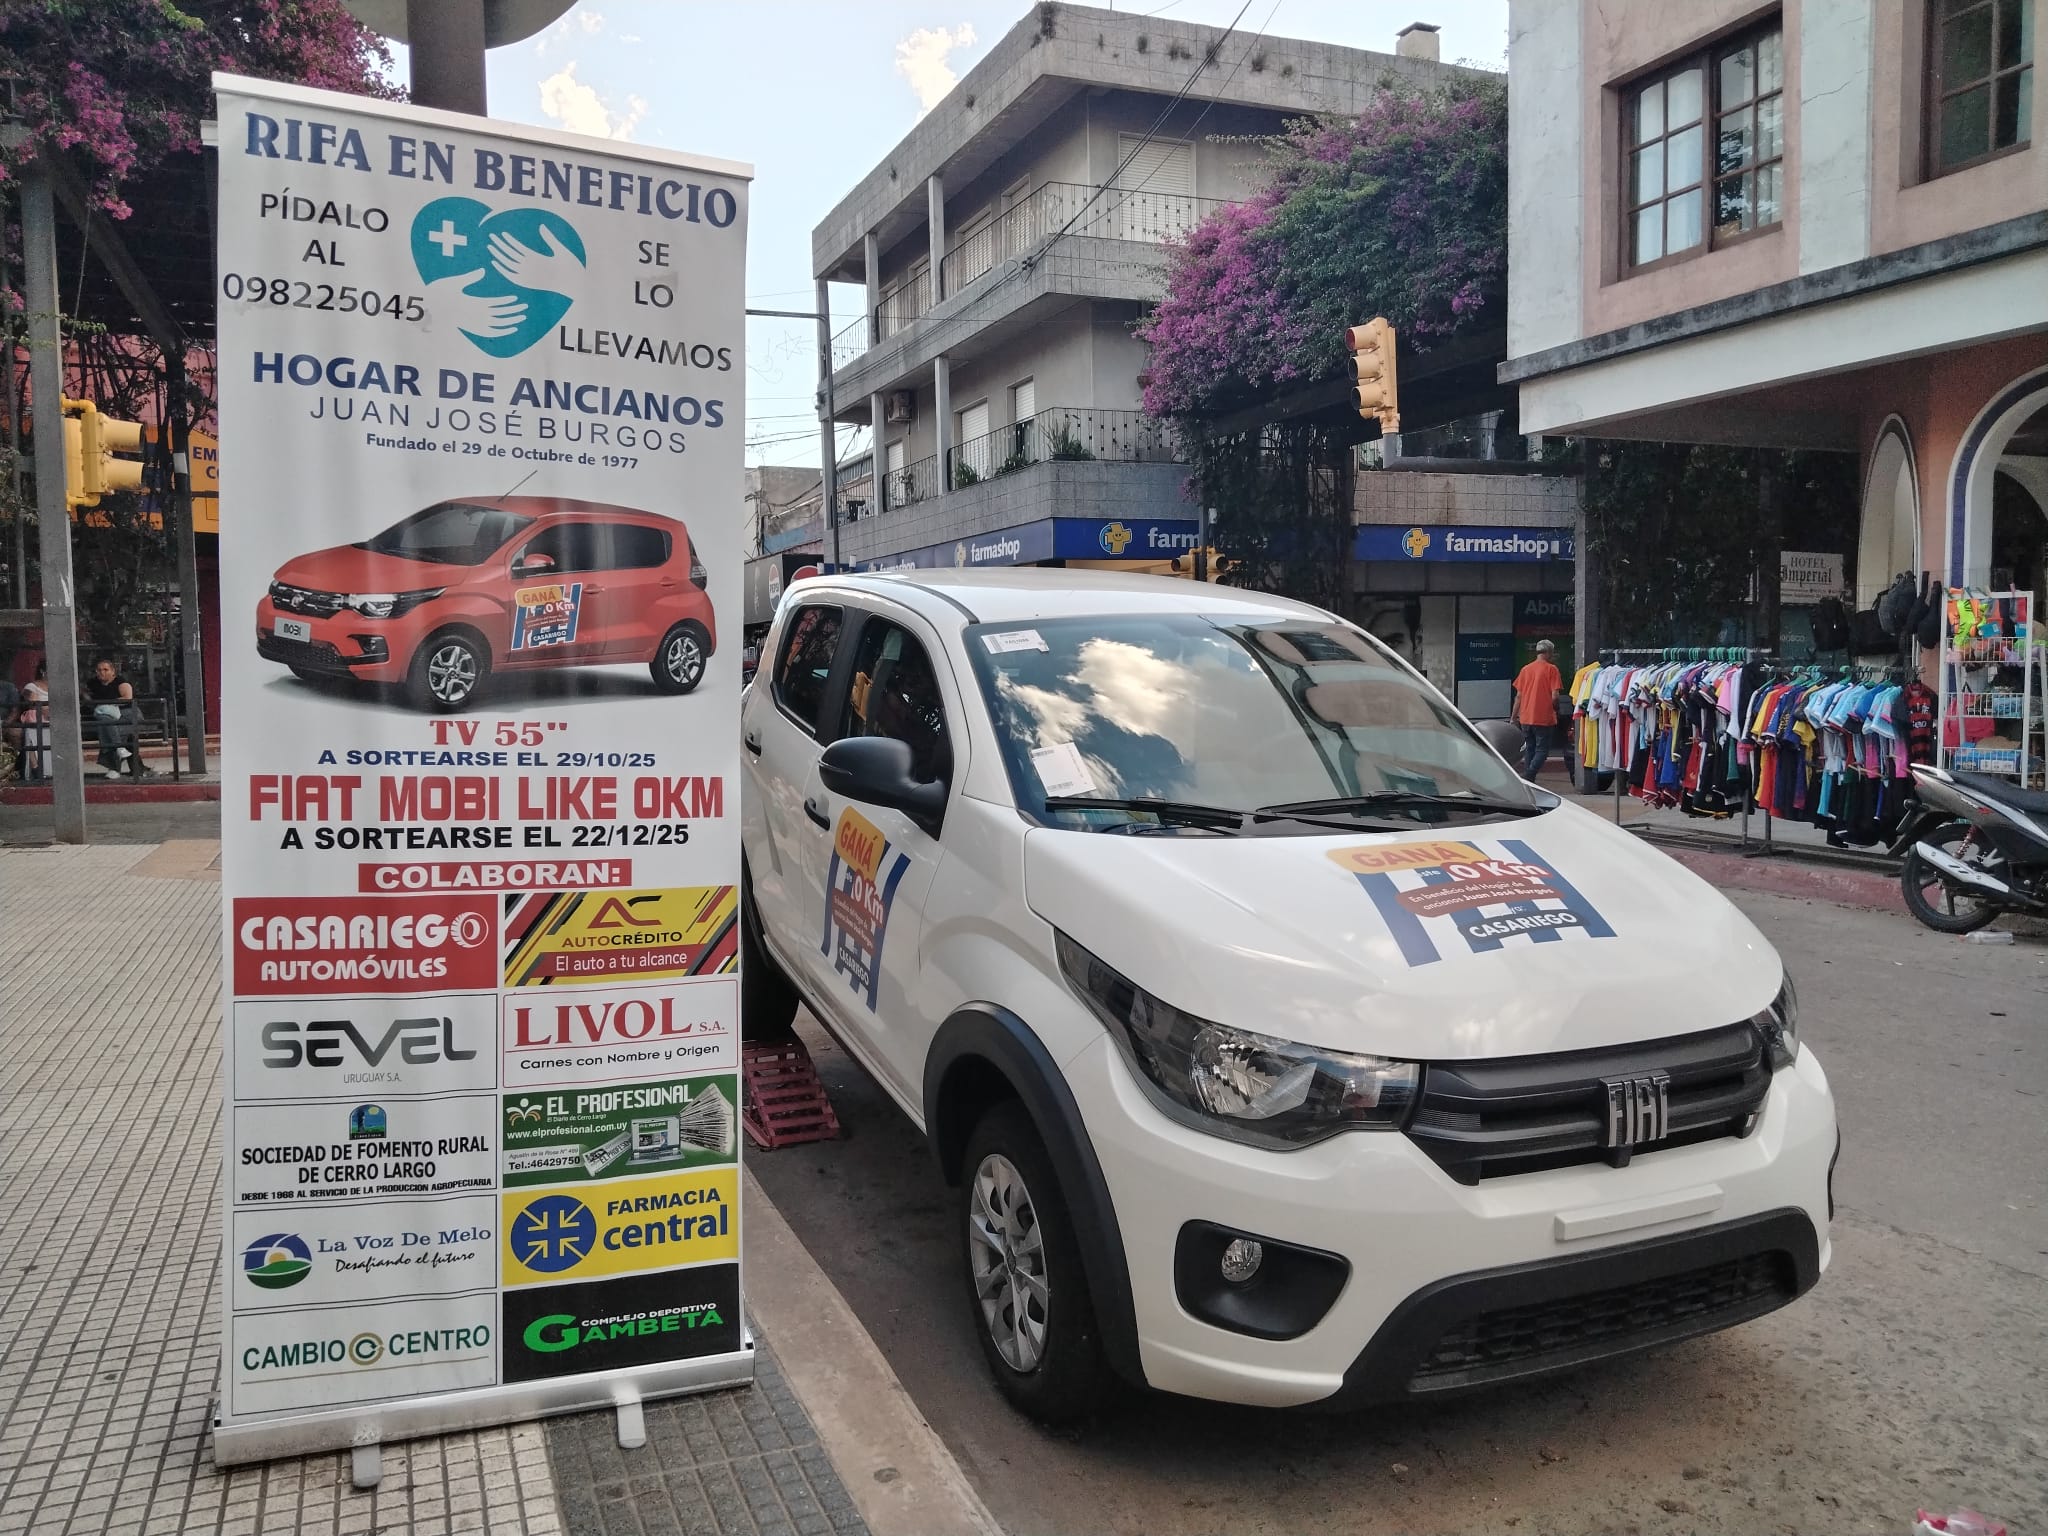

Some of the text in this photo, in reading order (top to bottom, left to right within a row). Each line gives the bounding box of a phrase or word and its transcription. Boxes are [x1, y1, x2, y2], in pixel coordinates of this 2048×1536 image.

[245, 112, 737, 229] RIFA EN BENEFICIO
[260, 188, 389, 233] PÍDALO
[302, 239, 345, 267] AL
[638, 240, 670, 267] SE
[222, 273, 425, 322] 098225045
[635, 280, 674, 308] LO
[559, 325, 732, 372] LLEVAMOS
[253, 351, 724, 429] HOGAR DE ANCIANOS
[311, 396, 686, 454] JUAN JOSÉ BURGOS
[366, 433, 639, 469] Fundado el 29 de Octubre de 1977
[970, 537, 1020, 563] farmashop
[1445, 532, 1549, 559] farmashop
[1790, 556, 1827, 569] HOTEL
[523, 588, 556, 604] GANÁ
[556, 600, 575, 611] Km
[430, 720, 481, 746] TV
[318, 750, 656, 768] A SORTEARSE EL 29/10/25
[250, 775, 361, 821] FIAT
[380, 775, 500, 821] MOBI
[517, 776, 616, 821] LIKE
[280, 824, 689, 849] A SORTEARSE EL 22/12/25
[840, 820, 879, 873] GANÁ
[1352, 843, 1467, 867] GANÁ
[374, 863, 621, 890] COLABORAN:
[1477, 861, 1549, 878] Km
[1464, 883, 1480, 893] del
[1464, 892, 1491, 902] Juan
[240, 911, 489, 951] CASARIEGO
[1468, 912, 1578, 938] CASARIEGO
[561, 930, 682, 948] AUTOCRÉDITO
[260, 956, 447, 981] AUTOMÓVILES
[555, 950, 688, 971] El auto a tu alcance
[514, 997, 726, 1047] LIVOL S.A.
[261, 1016, 477, 1069] SEVEL
[519, 1044, 720, 1070] Carnes con Nombre y Origen
[343, 1071, 401, 1084] URUGUAY S.A.
[547, 1084, 693, 1116] EL PROFESIONAL
[1607, 1075, 1671, 1148] FIAT
[507, 1122, 628, 1140] www.elprofesional.com.uy
[241, 1136, 489, 1165] SOCIEDAD DE FOMENTO RURAL
[299, 1161, 436, 1184] DE CERRO LARGO
[242, 1192, 269, 1201] DESDE
[297, 1189, 308, 1198] AL
[310, 1187, 348, 1198] SERVICIO
[350, 1186, 361, 1195] DE
[363, 1185, 374, 1194] LA
[376, 1183, 429, 1193] PRODUCCION
[431, 1178, 492, 1191] AGROPECUARIA
[606, 1188, 721, 1217] FARMACIA
[317, 1227, 492, 1254] La Voz De Melo
[602, 1204, 728, 1252] central
[335, 1250, 476, 1273] Desafiando el futuro
[581, 1303, 717, 1327] COMPLEJO DEPORTIVO
[523, 1309, 724, 1353] GAMBETA
[243, 1324, 490, 1371] CAMBIO CENTRO
